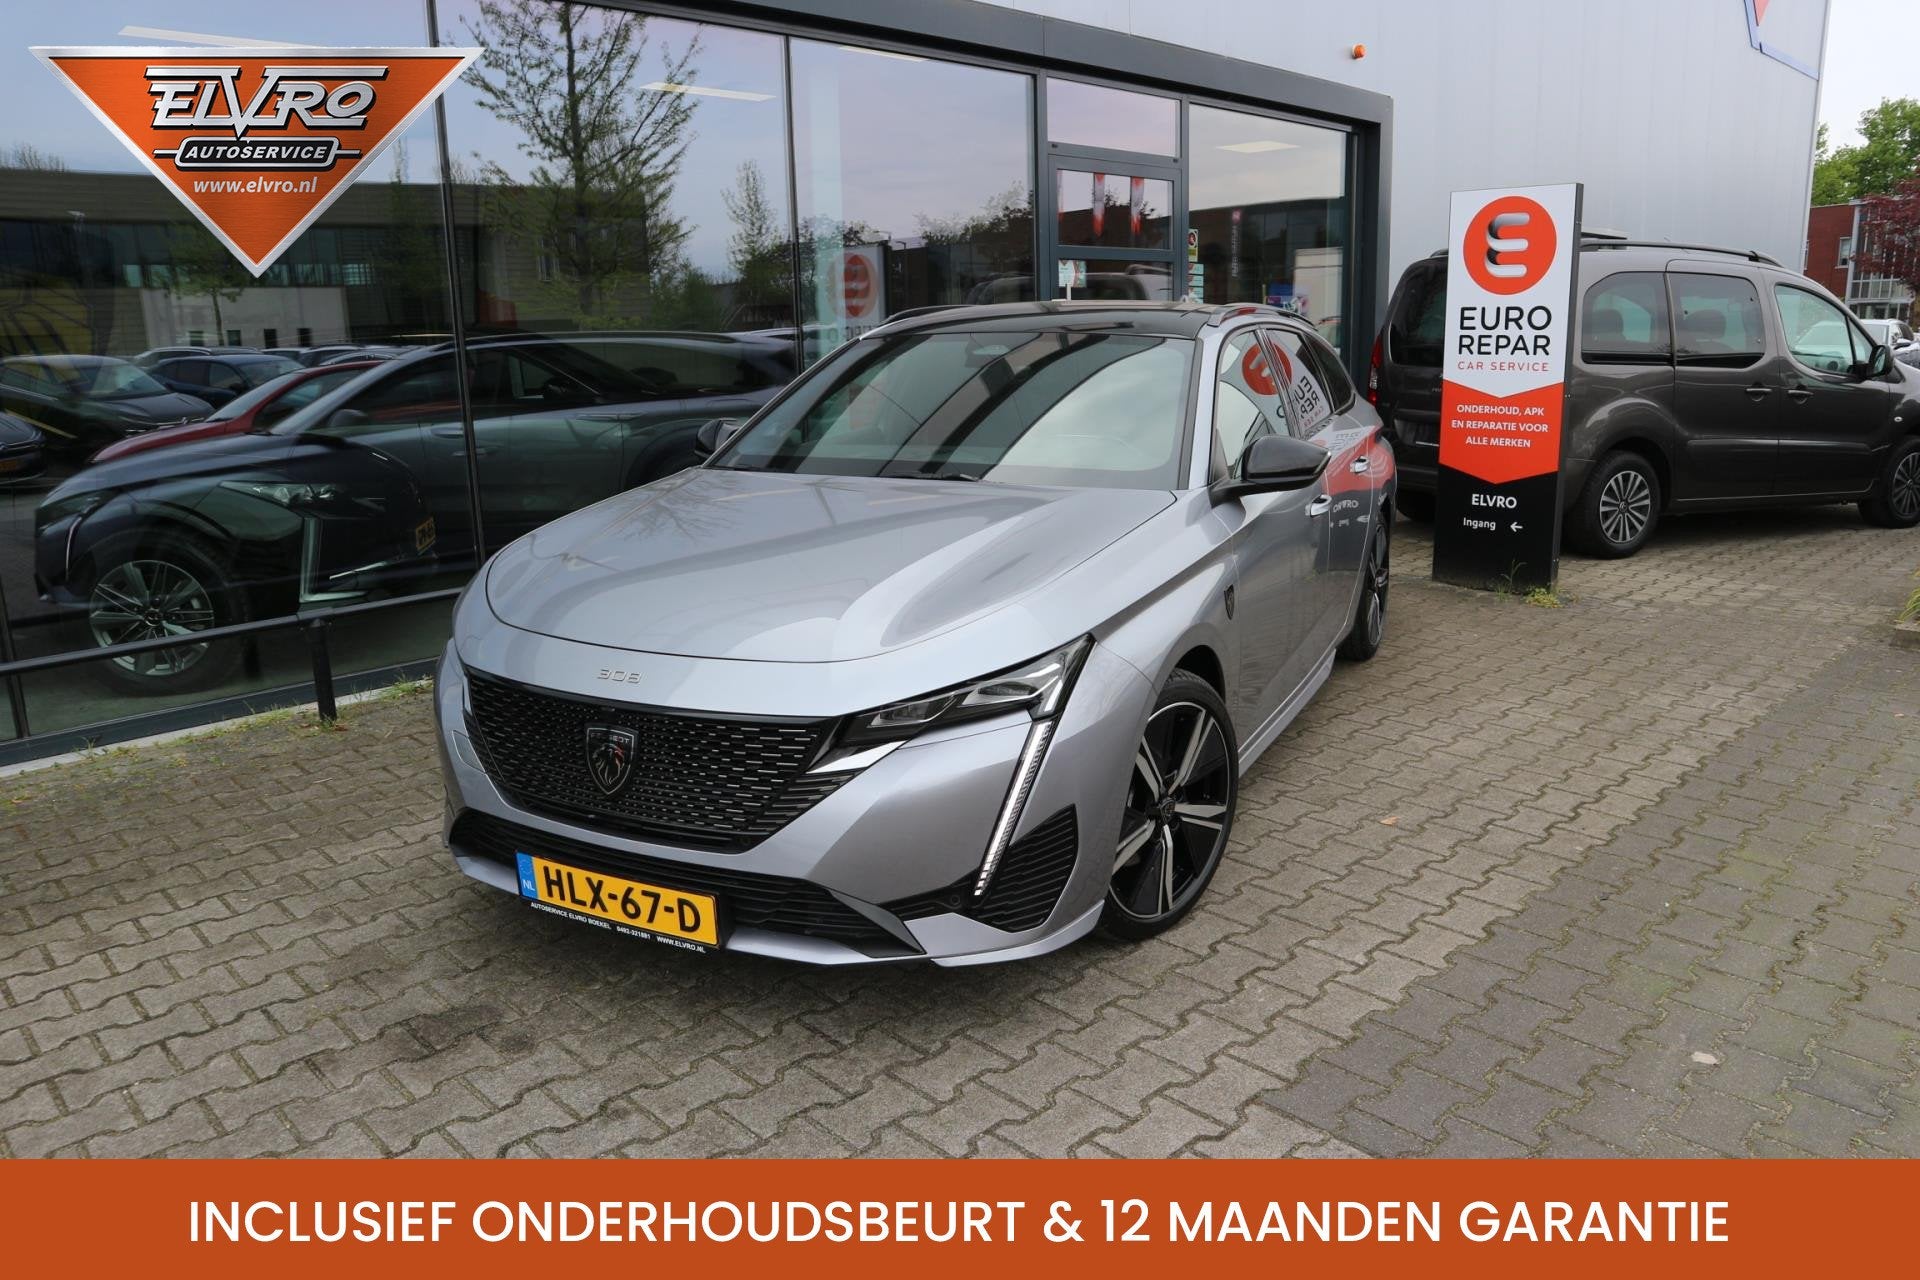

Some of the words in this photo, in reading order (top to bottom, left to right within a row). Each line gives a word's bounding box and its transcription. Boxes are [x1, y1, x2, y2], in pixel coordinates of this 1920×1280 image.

[1459, 305, 1552, 331] EURO
[1458, 334, 1551, 356] REPAR
[1457, 361, 1484, 370] CAR
[1490, 361, 1549, 372] SERVICE
[1456, 404, 1521, 416] ONDERHOUD,
[1523, 407, 1544, 416] APK
[1451, 419, 1464, 428] EN
[1466, 420, 1517, 431] REPARATIE
[1518, 423, 1549, 433] VOOR
[1465, 436, 1488, 445] ALLE
[1489, 438, 1531, 448] MERKEN
[1471, 493, 1518, 509] ELVRO
[1463, 517, 1497, 531] Ingang
[597, 668, 641, 684] 308
[522, 878, 536, 892] NL
[543, 865, 702, 934] HLX-67-D
[530, 901, 568, 918] AUTOSERVICE
[568, 912, 588, 924] ELVRO
[656, 935, 707, 954] WWW.ELVRO.NL
